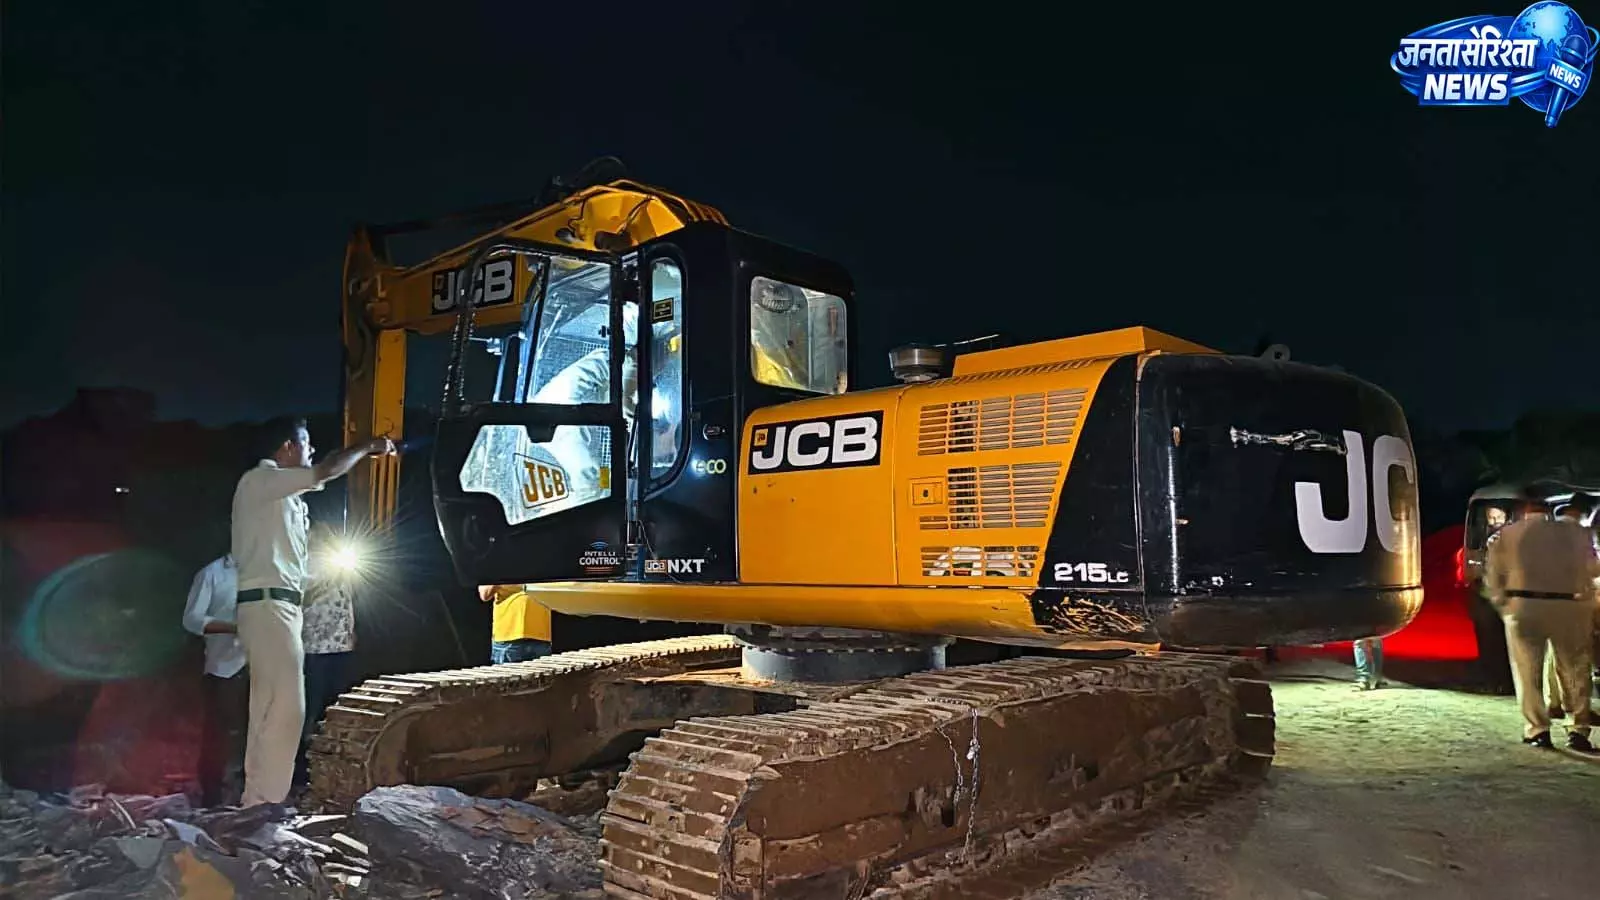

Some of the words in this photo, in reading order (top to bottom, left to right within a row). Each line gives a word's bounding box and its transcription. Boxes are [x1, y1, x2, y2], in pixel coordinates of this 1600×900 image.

[752, 416, 878, 470] JCB
[523, 460, 566, 503] JCB
[579, 556, 620, 566] CONTROL
[647, 561, 666, 571] JCB
[667, 559, 705, 573] NXT
[1054, 562, 1129, 583] 215LC
